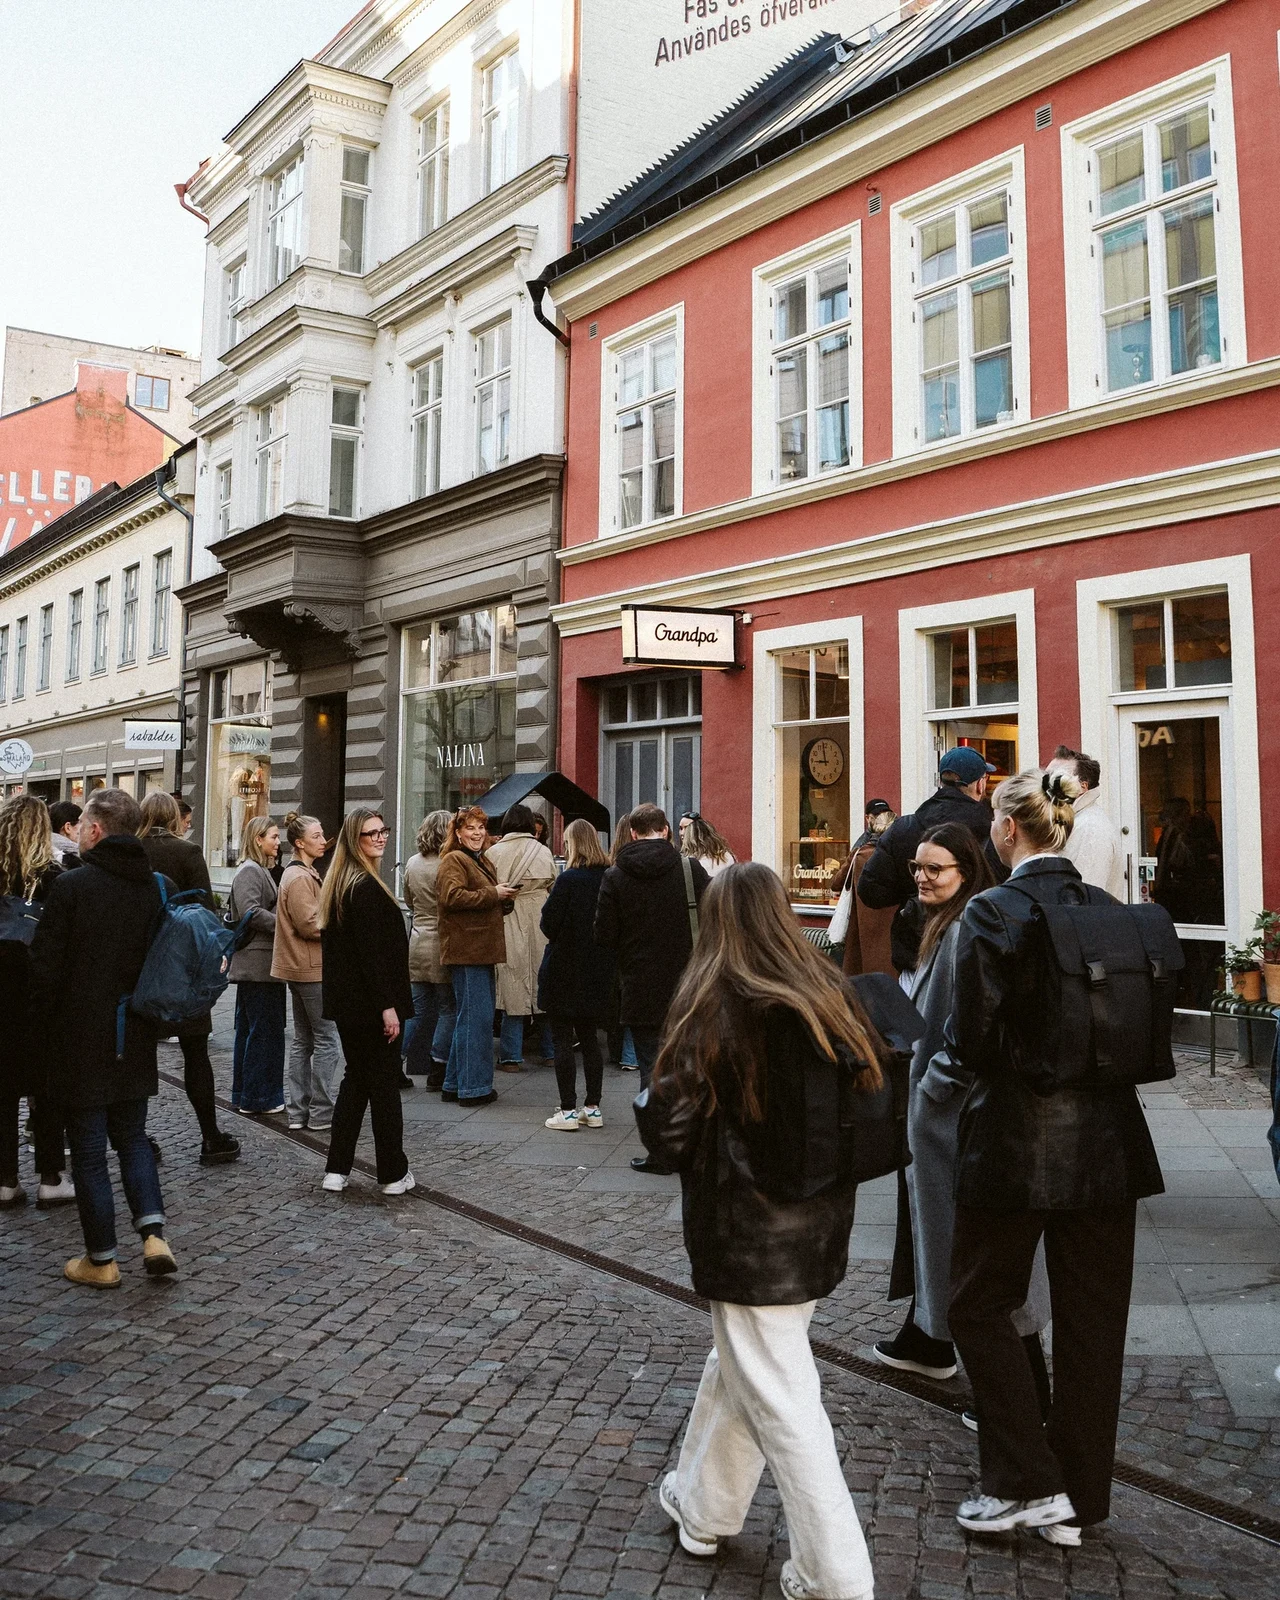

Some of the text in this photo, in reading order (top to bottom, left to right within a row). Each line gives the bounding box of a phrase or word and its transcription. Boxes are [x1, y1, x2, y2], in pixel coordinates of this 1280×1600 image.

[654, 15, 752, 67] Användes
[654, 622, 719, 647] Grandpa
[129, 729, 177, 742] rabalder
[436, 743, 485, 769] NALINA
